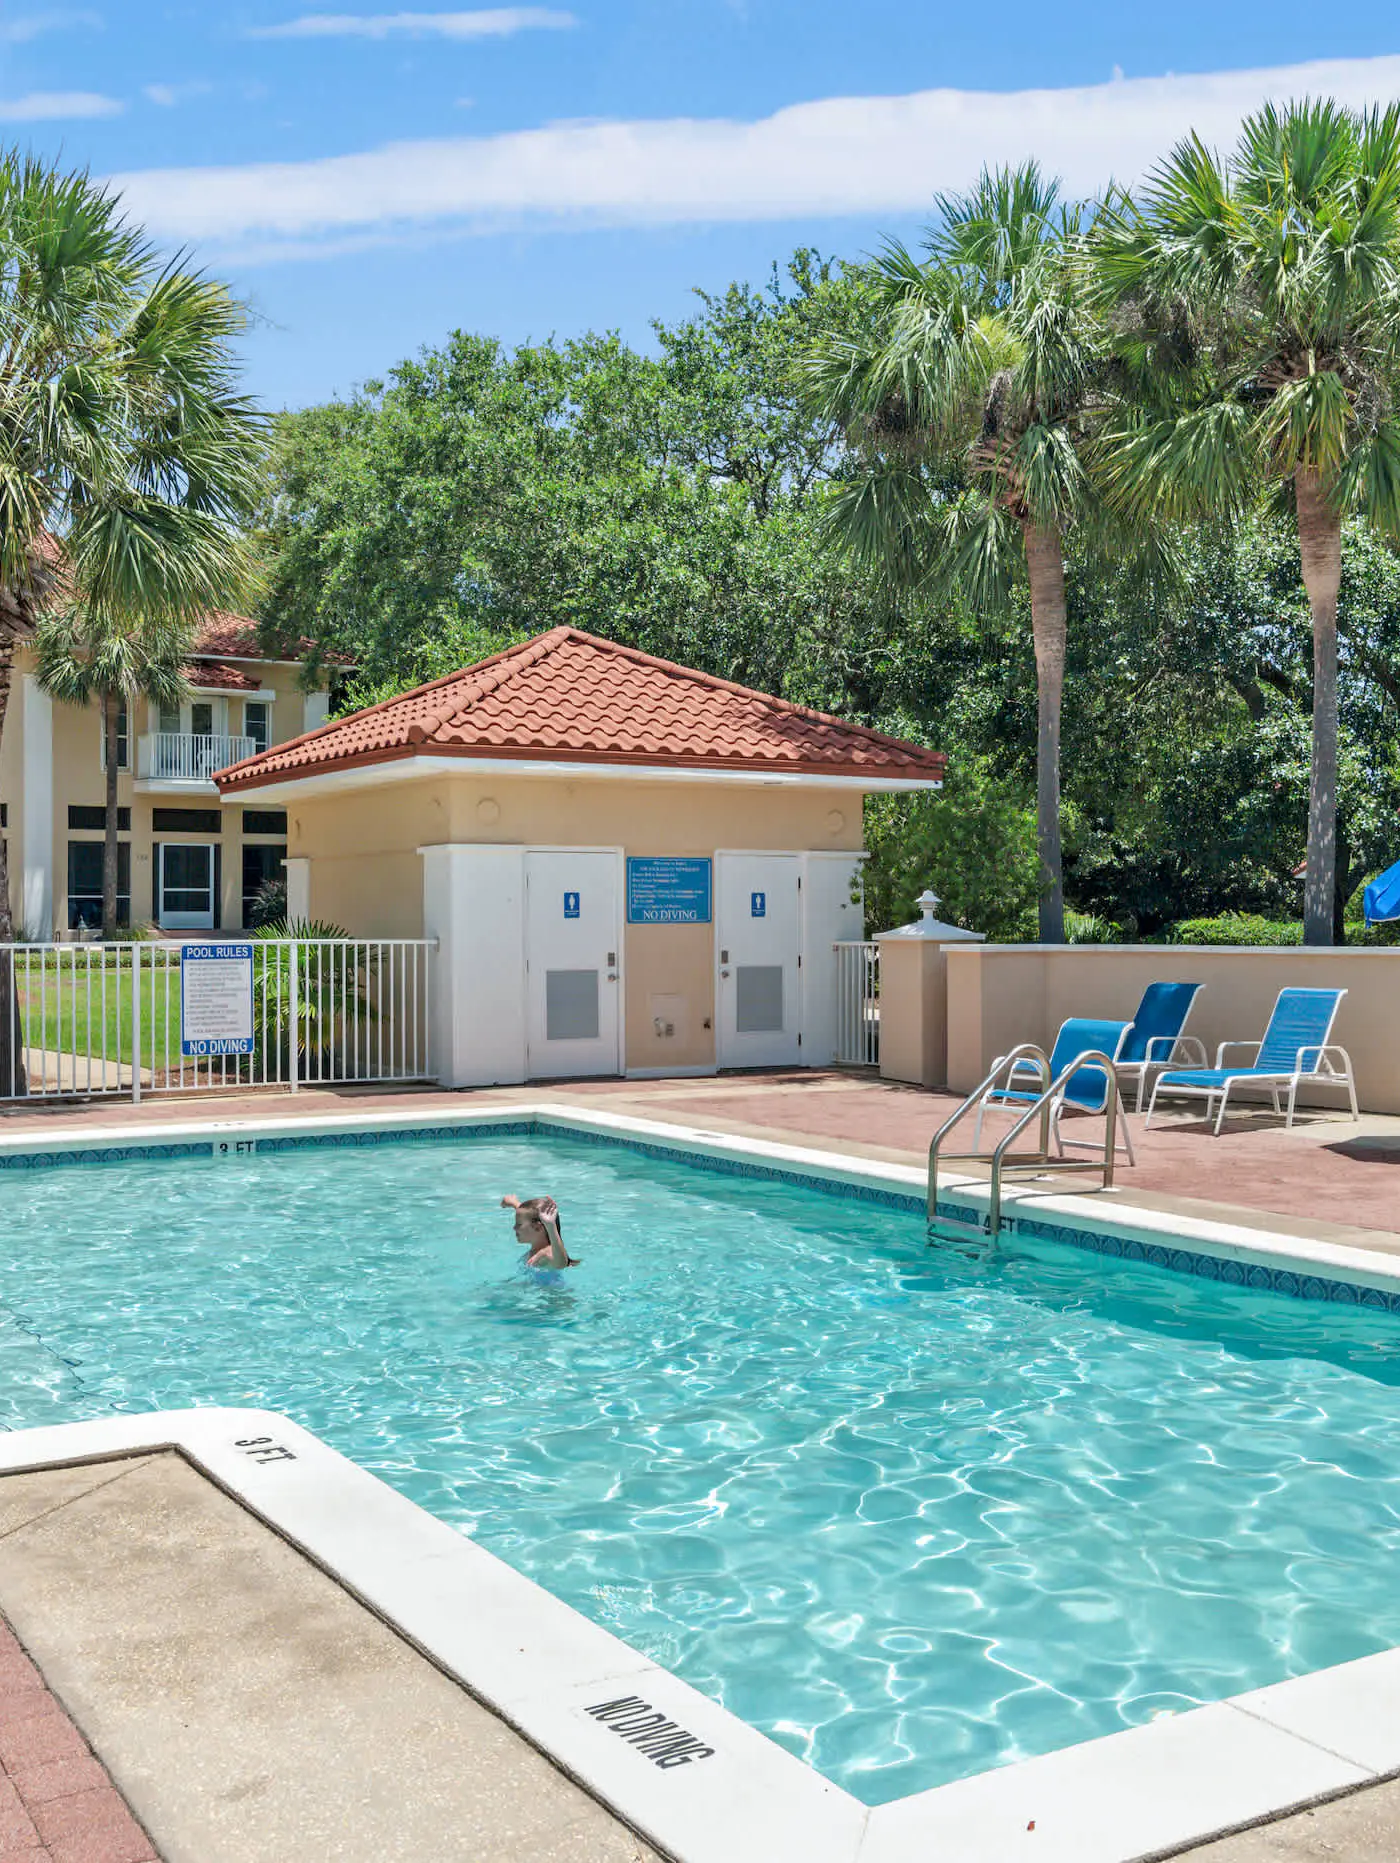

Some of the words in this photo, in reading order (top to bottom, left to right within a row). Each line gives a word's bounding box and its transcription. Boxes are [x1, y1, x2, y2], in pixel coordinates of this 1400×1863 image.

[643, 910, 659, 920] NO
[661, 910, 697, 920] DIVING
[186, 946, 214, 958] POOL
[216, 946, 249, 958] RULES
[189, 1041, 207, 1054] NO
[209, 1039, 248, 1053] DIVING
[235, 1140, 254, 1153] FT
[998, 1215, 1015, 1233] FT
[234, 1437, 273, 1447] 3
[245, 1446, 297, 1463] FT
[583, 1695, 653, 1721] NO
[607, 1712, 715, 1770] DIVING
